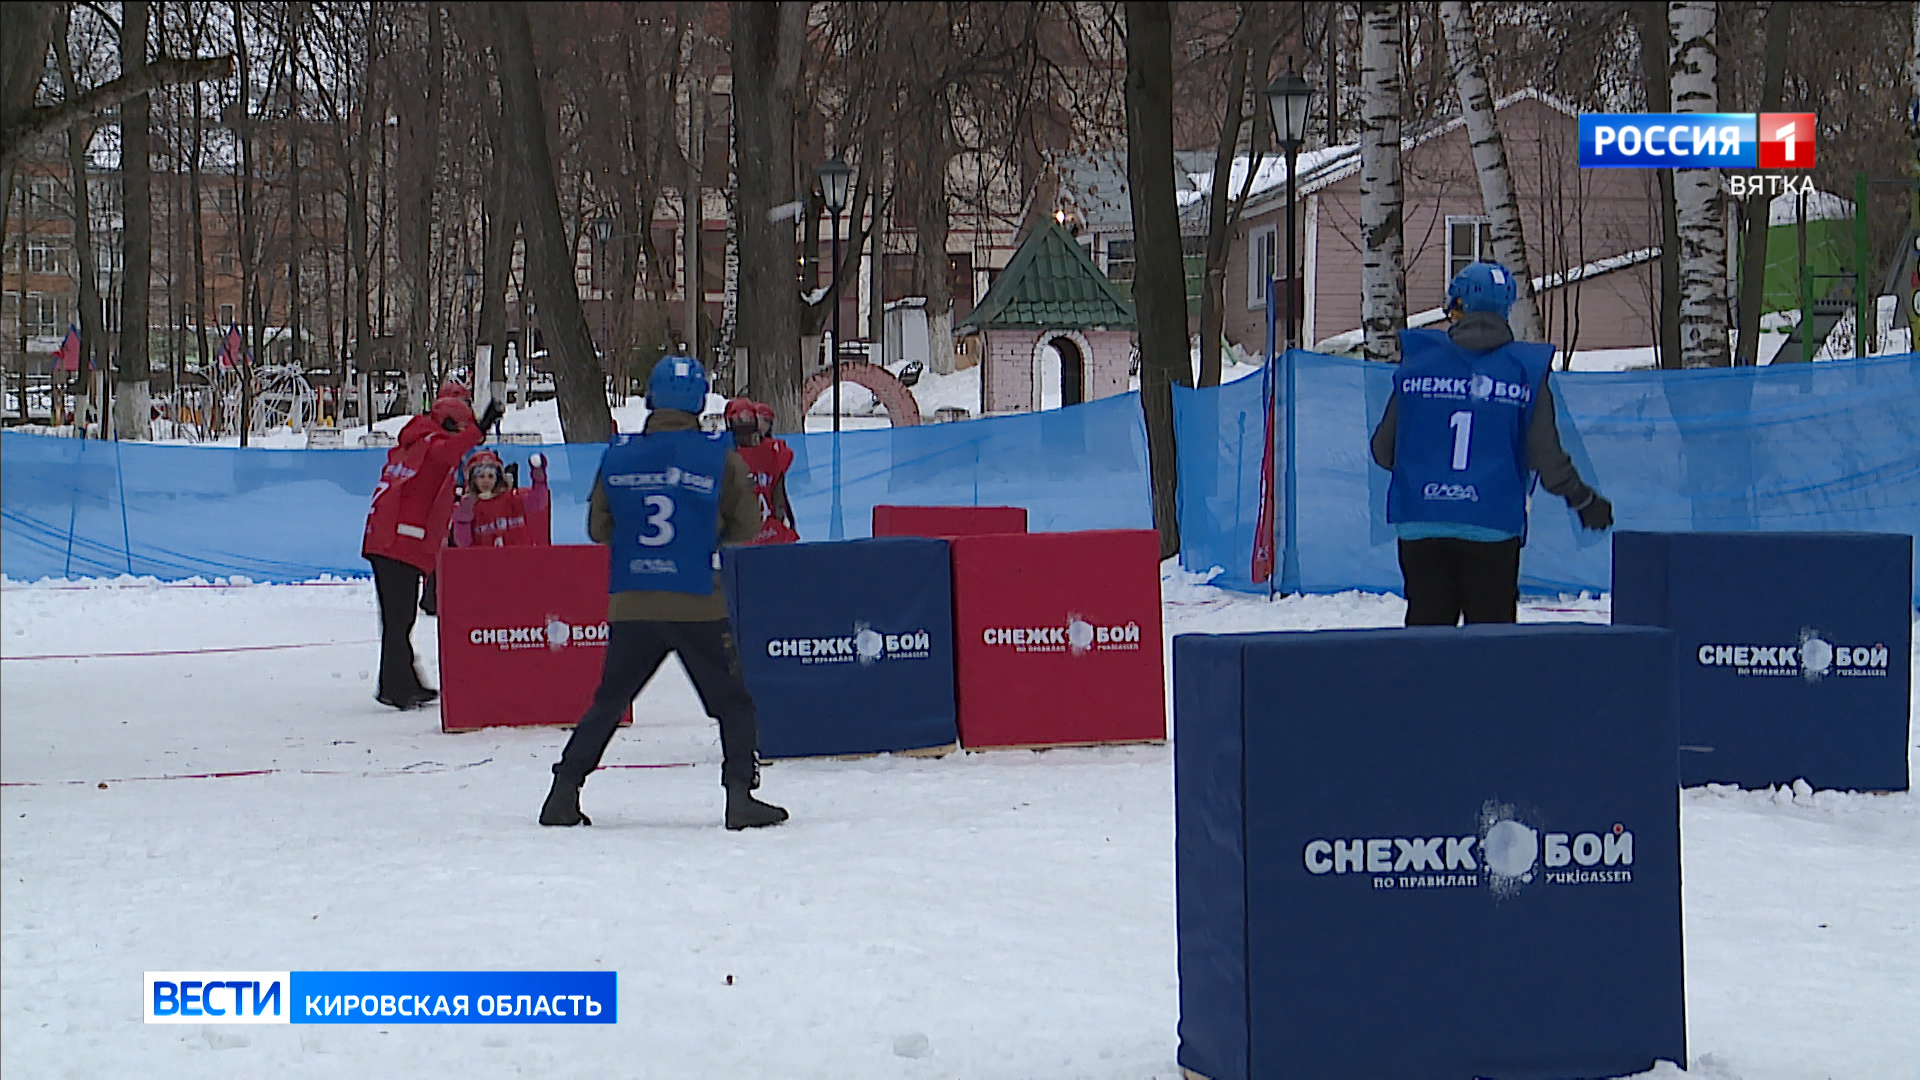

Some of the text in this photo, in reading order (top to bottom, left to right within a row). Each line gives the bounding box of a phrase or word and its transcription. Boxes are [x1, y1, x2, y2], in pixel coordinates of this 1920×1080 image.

[1450, 411, 1473, 470] 1
[638, 495, 676, 546] 3
[470, 621, 610, 644] СНЕЖК БОЙ
[768, 629, 930, 657] СНЕЖК БОЙ
[984, 621, 1140, 645] СНЕЖК БОЙ
[1699, 643, 1888, 667] СНЕЖК БОЙ
[1304, 823, 1633, 874] СНЕЖК БОЙ
[1373, 877, 1395, 889] ПО
